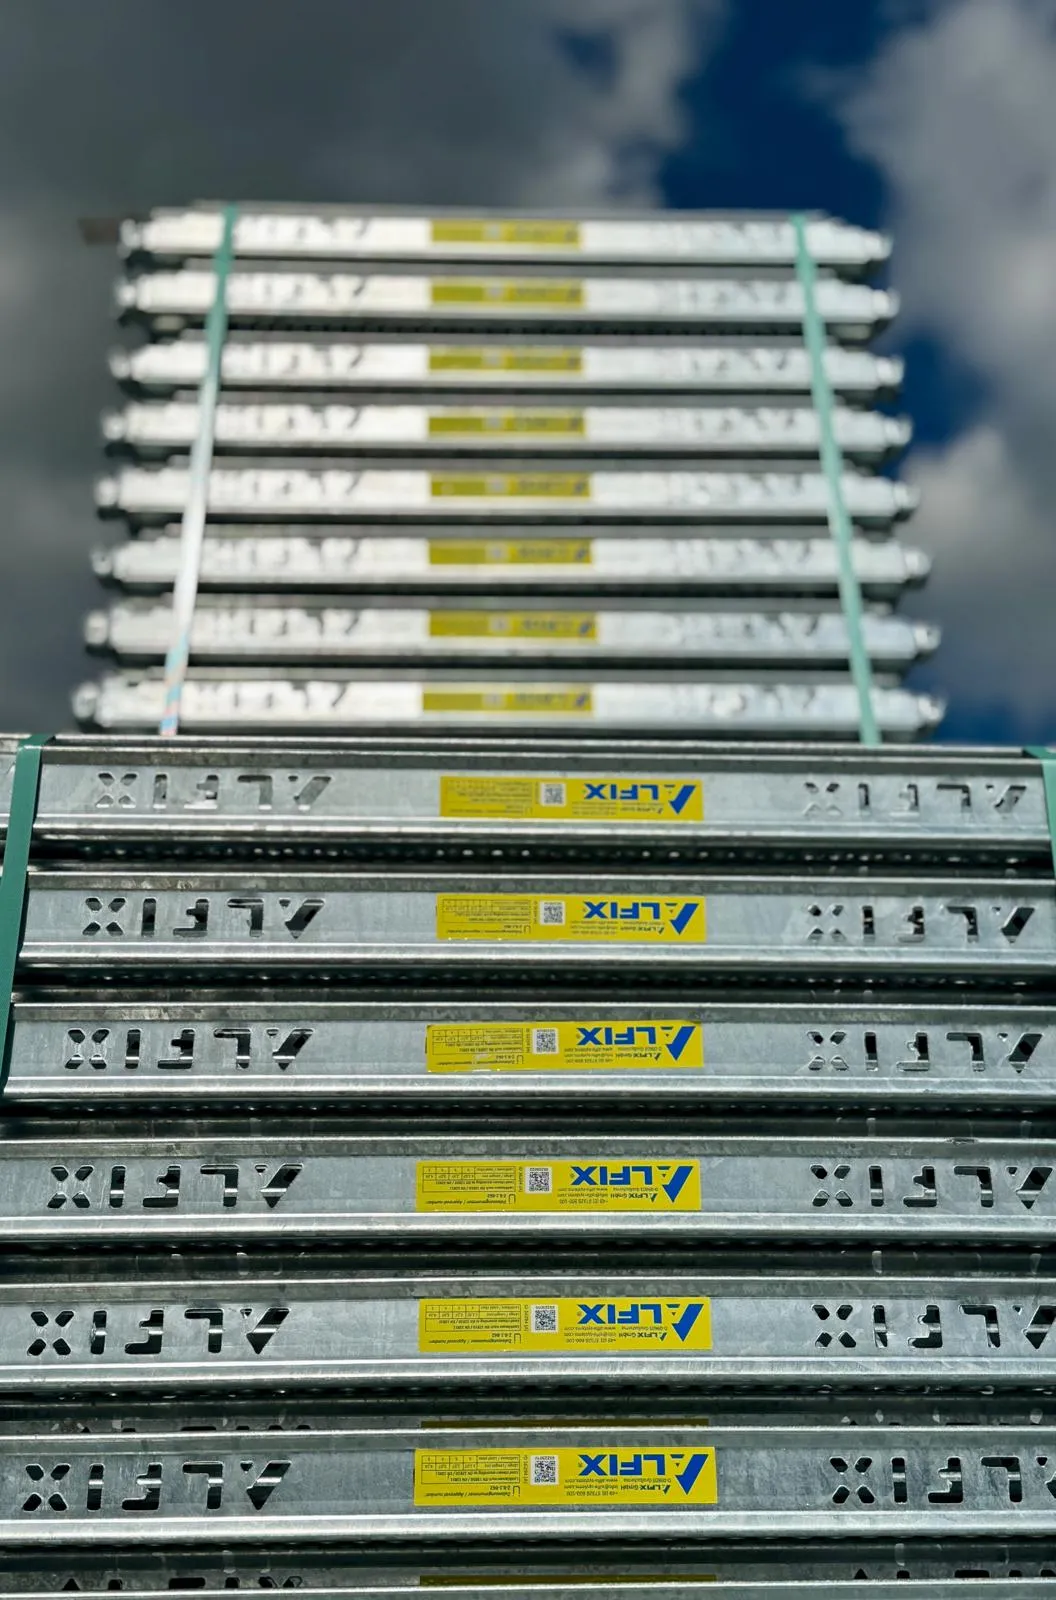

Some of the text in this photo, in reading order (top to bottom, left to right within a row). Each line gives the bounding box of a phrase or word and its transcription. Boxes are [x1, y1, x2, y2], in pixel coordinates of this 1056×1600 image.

[96, 773, 334, 811] ALFIX
[584, 784, 696, 815] ALFIX
[82, 896, 326, 939] ALFIX
[584, 902, 699, 935] ALFIX
[806, 905, 1036, 943] ALFIX
[65, 1028, 315, 1070] ALFIX
[577, 1027, 696, 1061] ALFIX
[806, 1031, 1043, 1073] ALFIX
[47, 1164, 304, 1208] ALFIX
[571, 1166, 694, 1203] ALFIX
[809, 1164, 1054, 1209] ALFIX
[27, 1308, 291, 1356] ALFIX
[577, 1304, 704, 1342] ALFIX
[638, 1332, 668, 1342] ALFIX
[812, 1304, 1056, 1349] ALFIX
[22, 1461, 292, 1512] ALFIX
[578, 1454, 709, 1496] ALFIX
[640, 1485, 671, 1496] ALFIX
